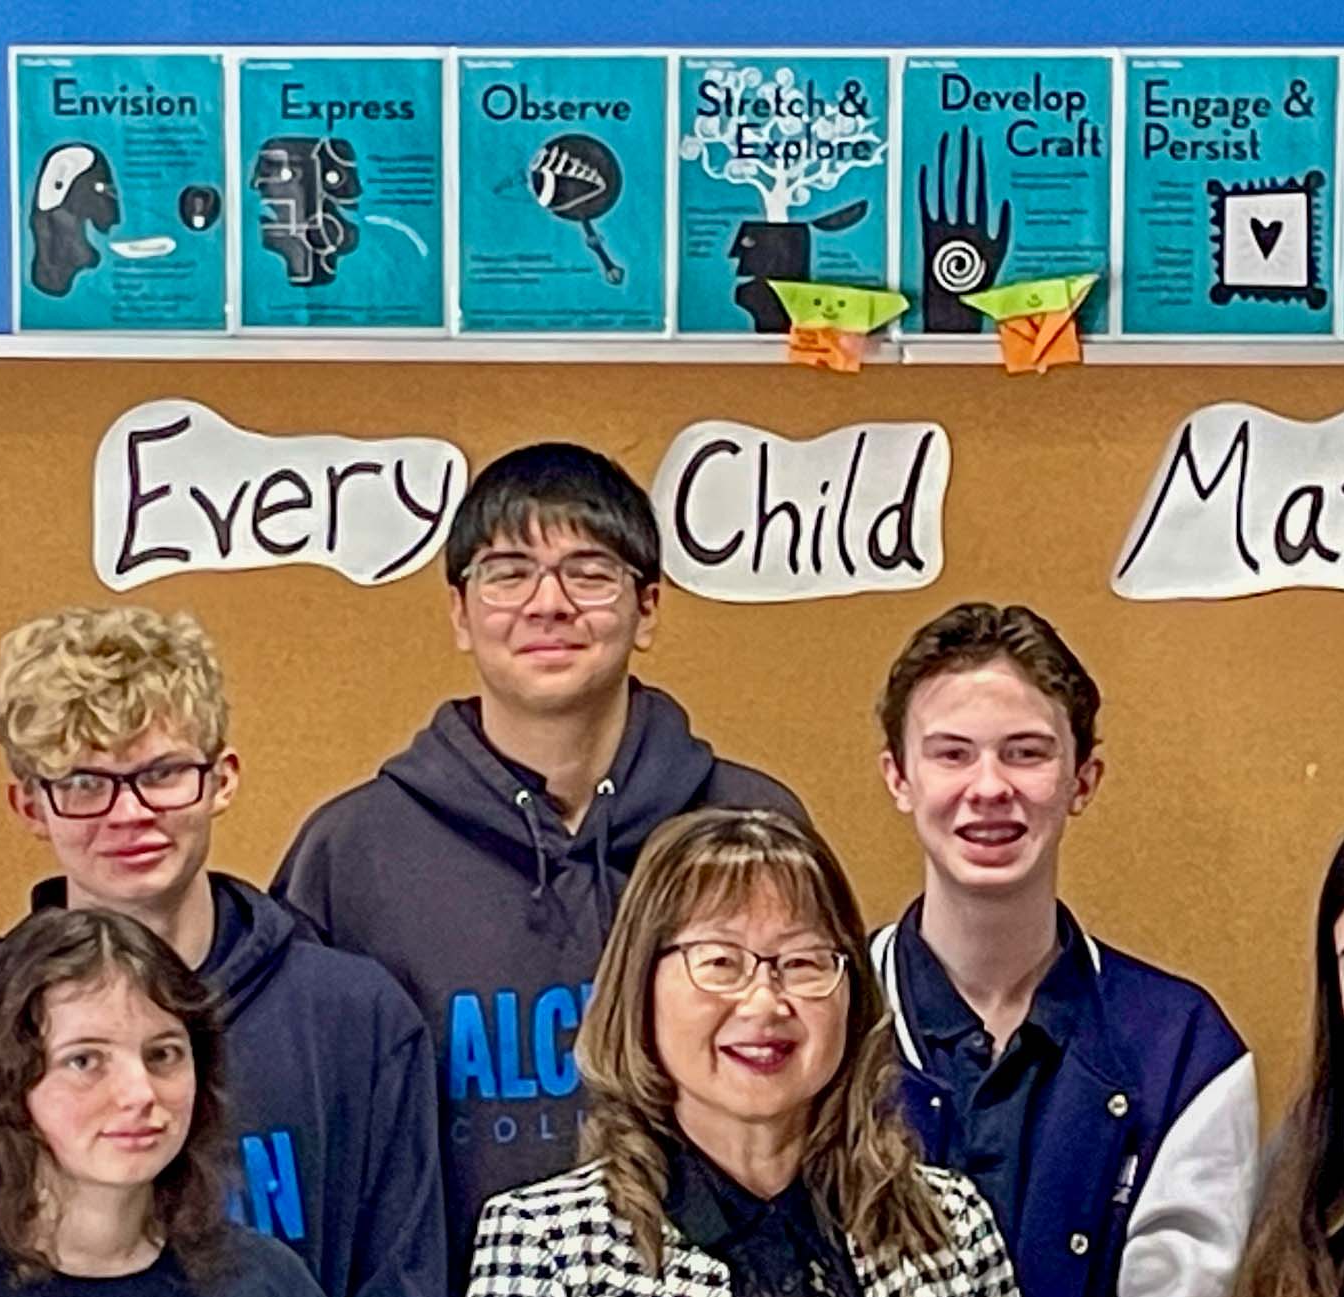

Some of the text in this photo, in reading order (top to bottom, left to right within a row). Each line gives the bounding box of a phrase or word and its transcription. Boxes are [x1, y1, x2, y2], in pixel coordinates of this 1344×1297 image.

[53, 77, 198, 116] Envision
[280, 83, 415, 131] Express
[482, 83, 632, 121] Observe
[696, 79, 871, 118] Stretch &
[941, 72, 1087, 122] Develop
[1144, 79, 1315, 129] Engage &
[736, 122, 873, 169] Explore
[1006, 117, 1102, 157] Craft
[1144, 122, 1261, 160] Persist
[115, 416, 454, 581] Every
[675, 431, 936, 578] Child
[449, 983, 594, 1098] ALC
